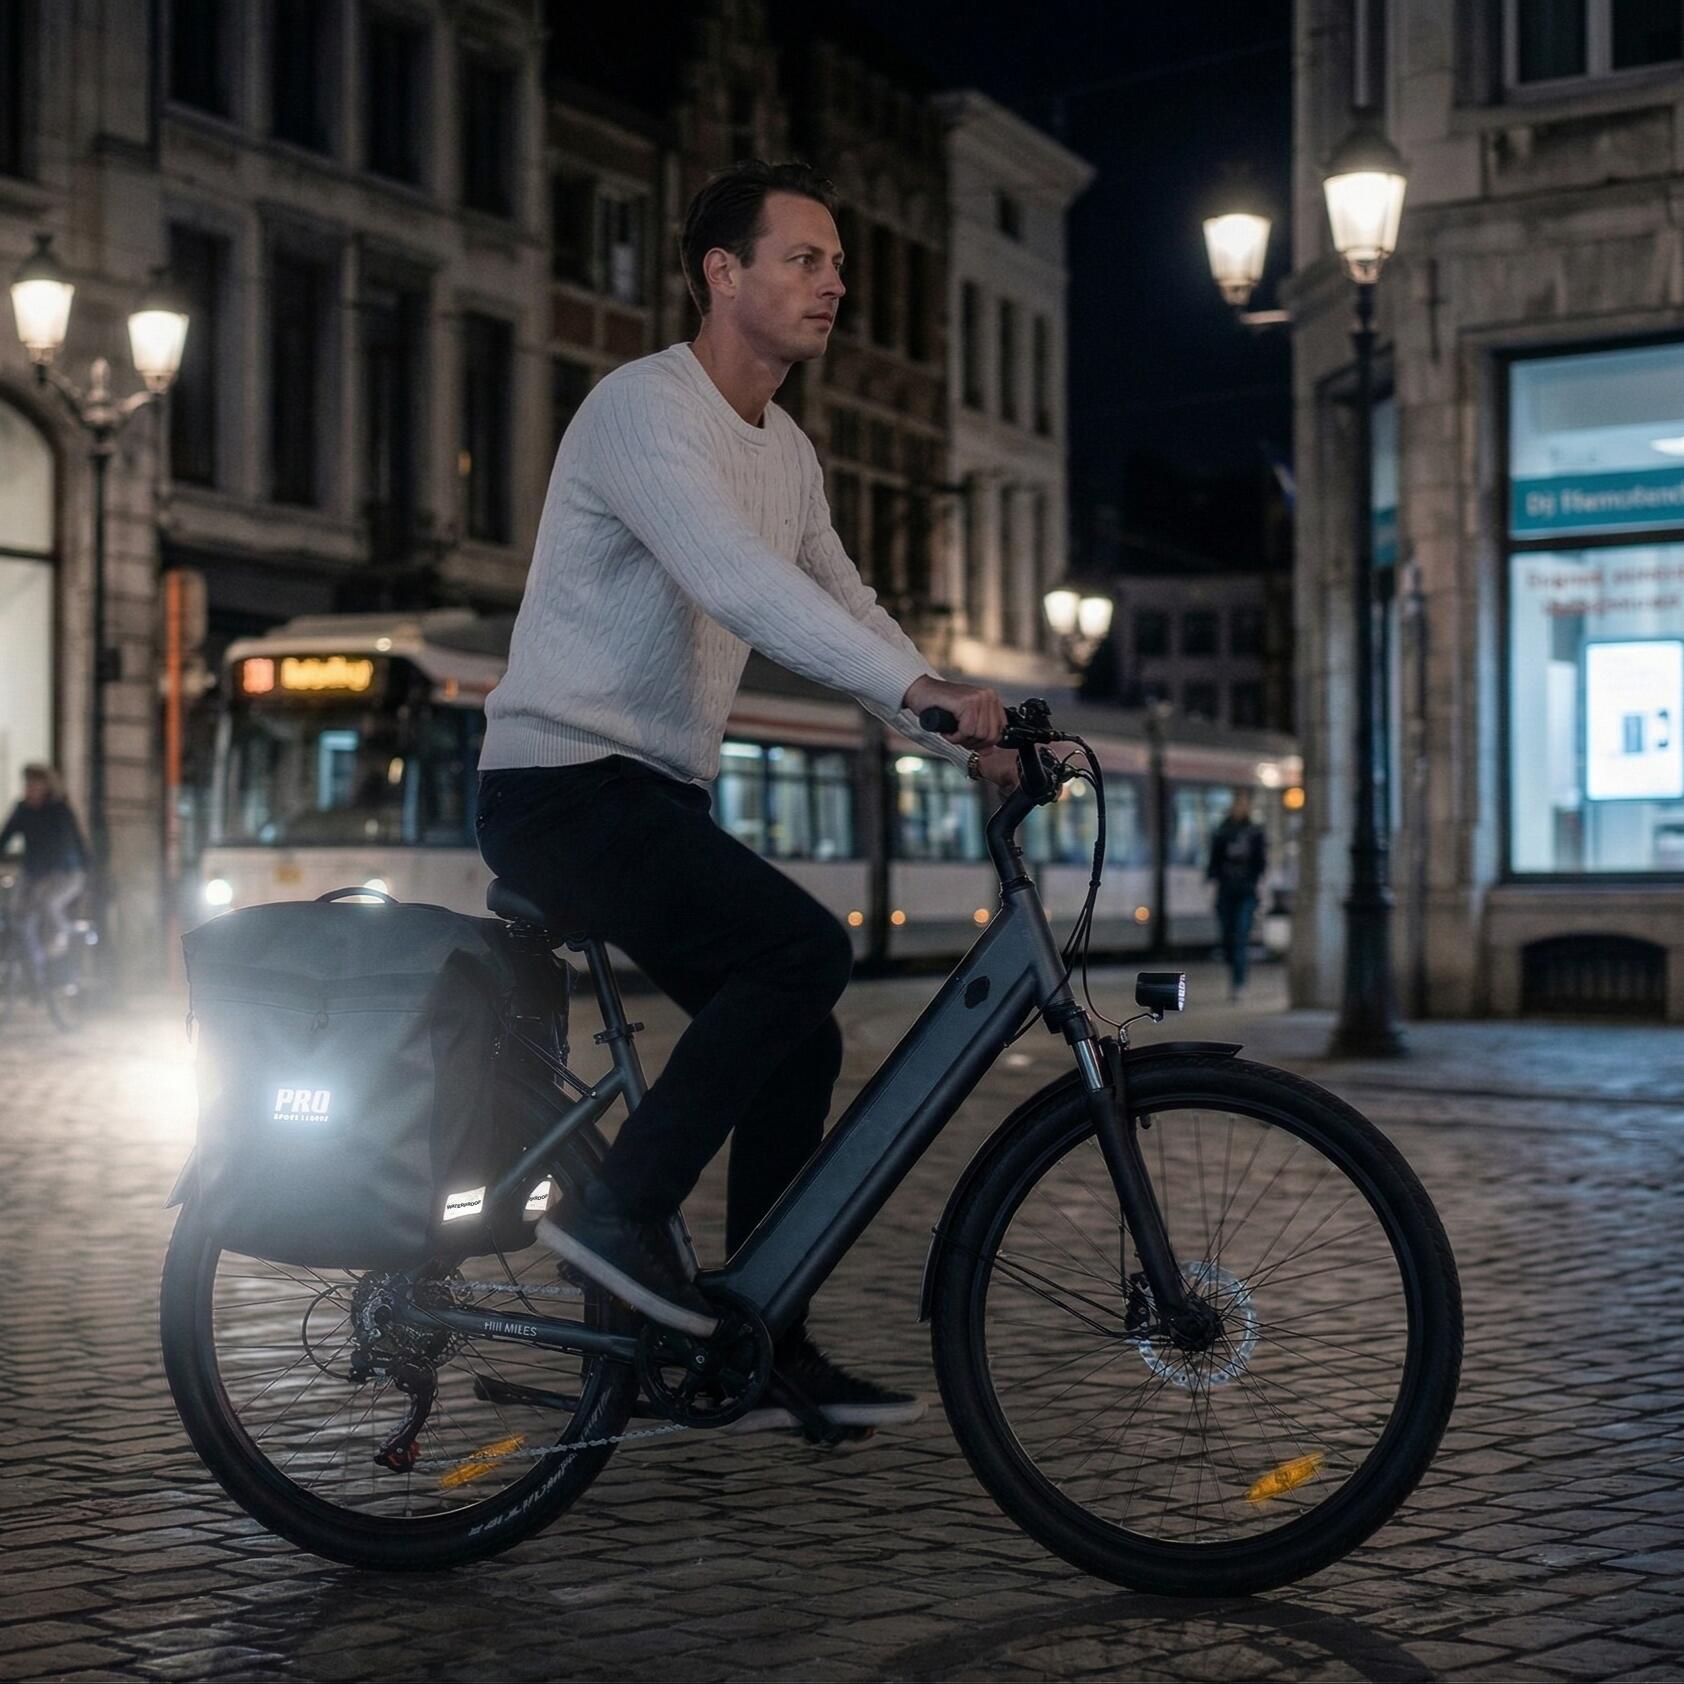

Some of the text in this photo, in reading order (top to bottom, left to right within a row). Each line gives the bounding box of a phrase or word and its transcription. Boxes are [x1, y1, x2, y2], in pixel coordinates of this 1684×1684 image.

[275, 1088, 330, 1113] PRO
[447, 1200, 481, 1209] WATERPROOF
[504, 1323, 537, 1337] MILES
